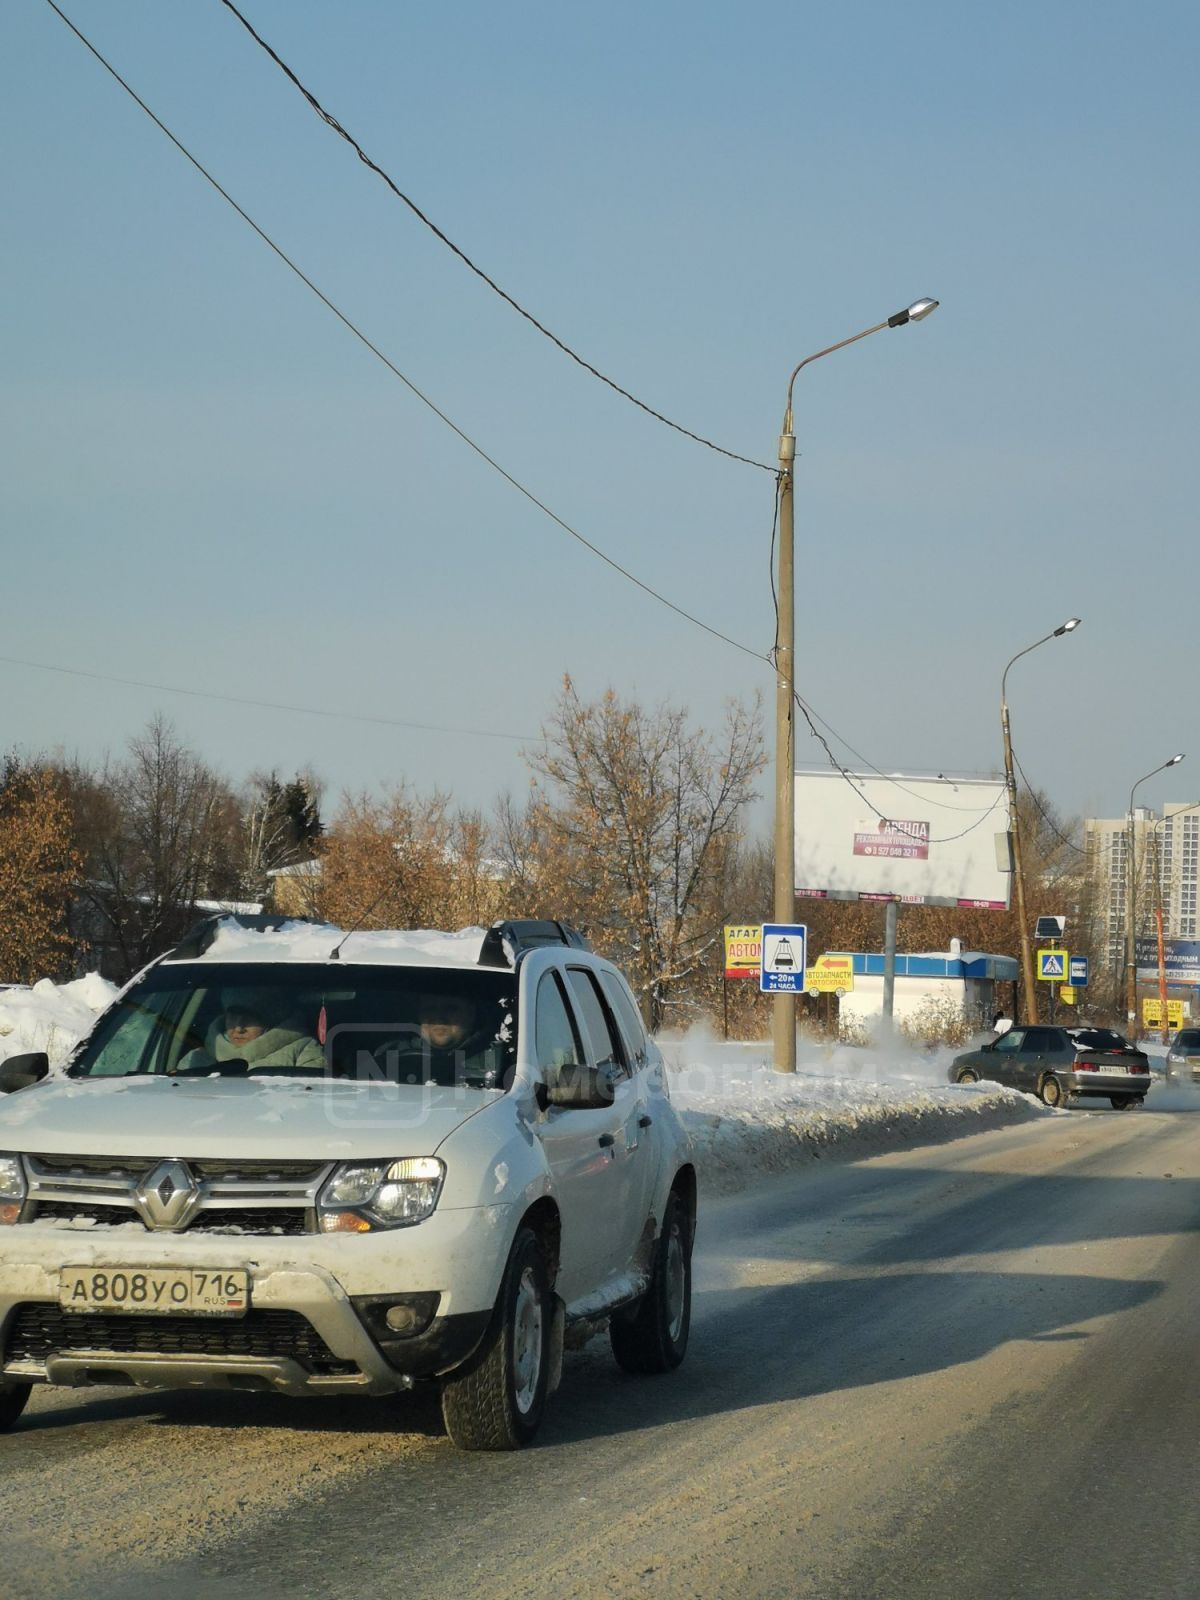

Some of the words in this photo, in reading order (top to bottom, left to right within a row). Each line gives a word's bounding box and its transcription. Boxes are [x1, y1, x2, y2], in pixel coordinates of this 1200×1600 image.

[884, 821, 927, 836] АРЕНДА
[729, 929, 758, 938] АГАТ
[71, 1273, 189, 1303] А808УО
[194, 1274, 239, 1297] 716
[204, 1297, 226, 1305] RUS
